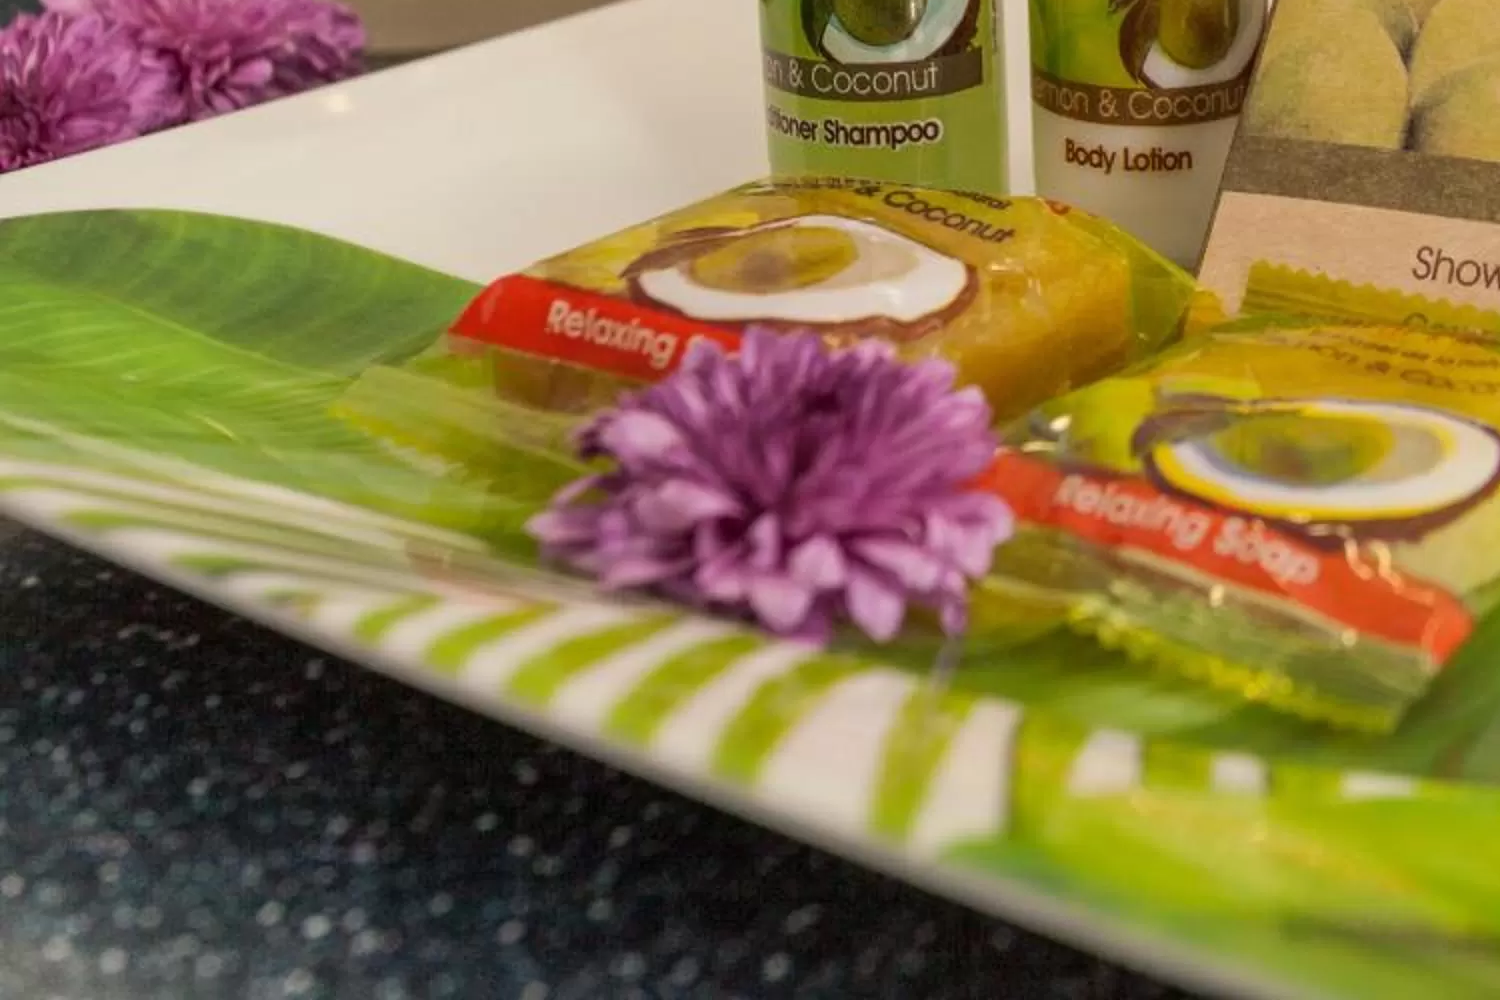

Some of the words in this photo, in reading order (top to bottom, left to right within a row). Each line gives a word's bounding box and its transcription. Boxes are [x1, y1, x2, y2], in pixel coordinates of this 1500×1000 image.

[788, 58, 805, 89] &
[811, 61, 939, 95] Coconut
[1098, 89, 1120, 118] &
[823, 118, 940, 150] Shampoo
[1064, 137, 1117, 175] Body
[1123, 146, 1193, 172] Lotion
[882, 189, 1016, 243] Coconut
[546, 298, 679, 371] Relaxing
[1055, 473, 1212, 552] Relaxing
[1212, 515, 1322, 586] Soap
